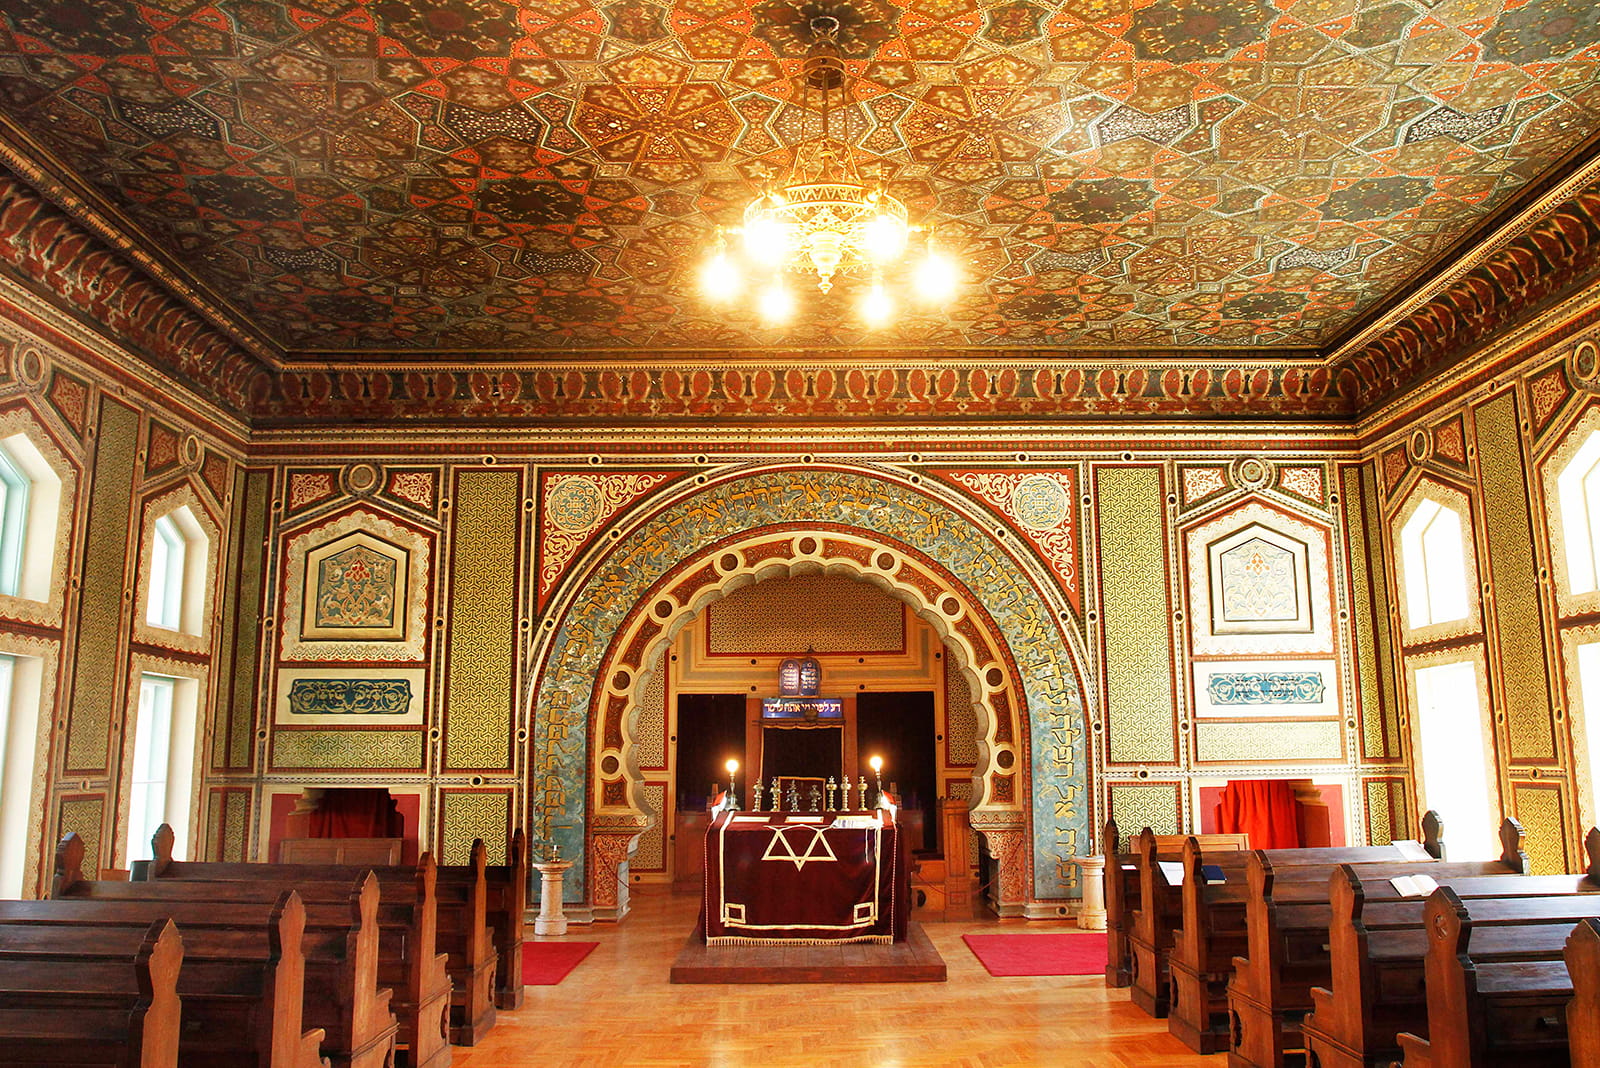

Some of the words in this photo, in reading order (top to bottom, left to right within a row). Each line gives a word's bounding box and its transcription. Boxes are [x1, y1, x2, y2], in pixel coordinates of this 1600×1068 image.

[730, 485, 784, 511] הרנה
[788, 475, 823, 503] אל
[824, 482, 892, 512] לשמע
[683, 495, 732, 530] ואל
[893, 498, 945, 538] אלהי
[617, 517, 687, 577] התפלה
[582, 572, 626, 617] אשר
[970, 544, 1025, 607] תחנתו
[1012, 599, 1049, 648] ואל
[555, 623, 594, 682] עבדך
[1027, 647, 1068, 708] עבדך
[537, 686, 573, 769] מתפלל
[784, 703, 801, 712] אתה
[830, 703, 841, 712] דע
[1048, 709, 1080, 778] תפלת
[537, 774, 573, 840] לפניך
[1053, 784, 1083, 818] אל
